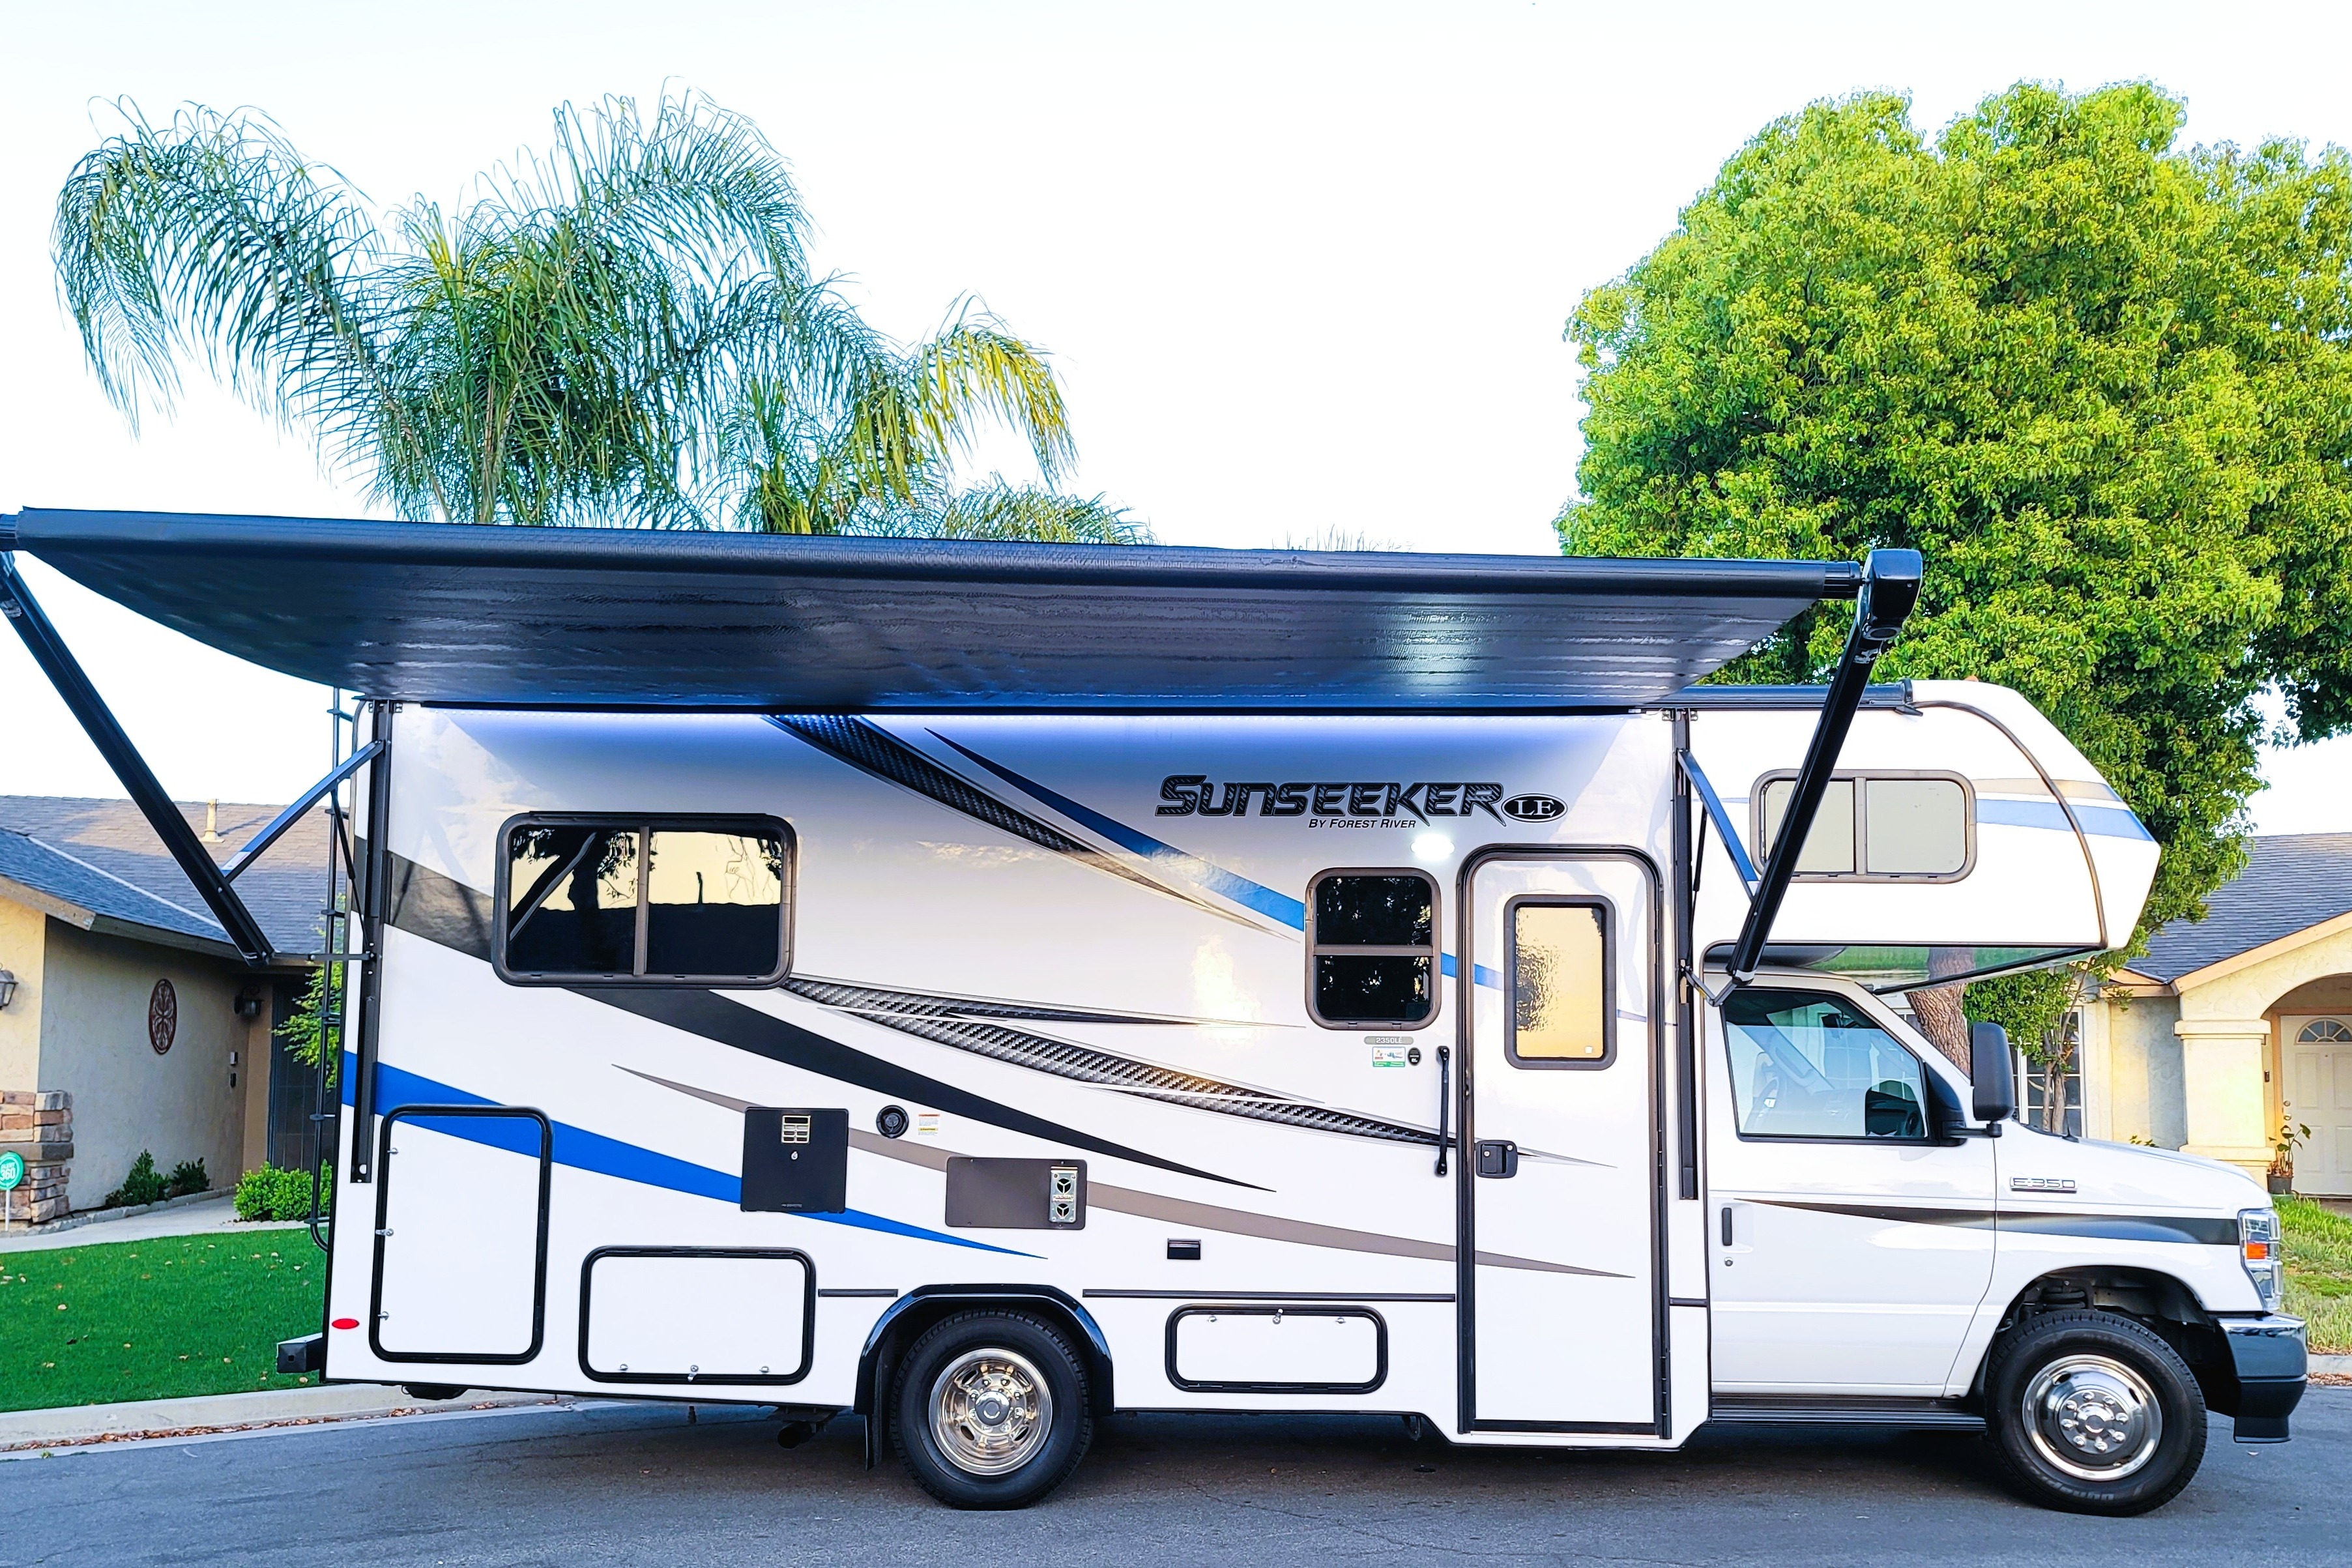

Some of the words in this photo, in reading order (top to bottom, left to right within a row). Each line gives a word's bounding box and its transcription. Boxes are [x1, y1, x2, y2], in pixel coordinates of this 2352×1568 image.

[1155, 775, 1507, 827] SUNSEEKER
[1514, 800, 1556, 817] LE
[1309, 819, 1326, 828] BY
[1329, 819, 1377, 828] FOREST
[1380, 819, 1417, 828] RIVER
[0, 1167, 16, 1181] 360
